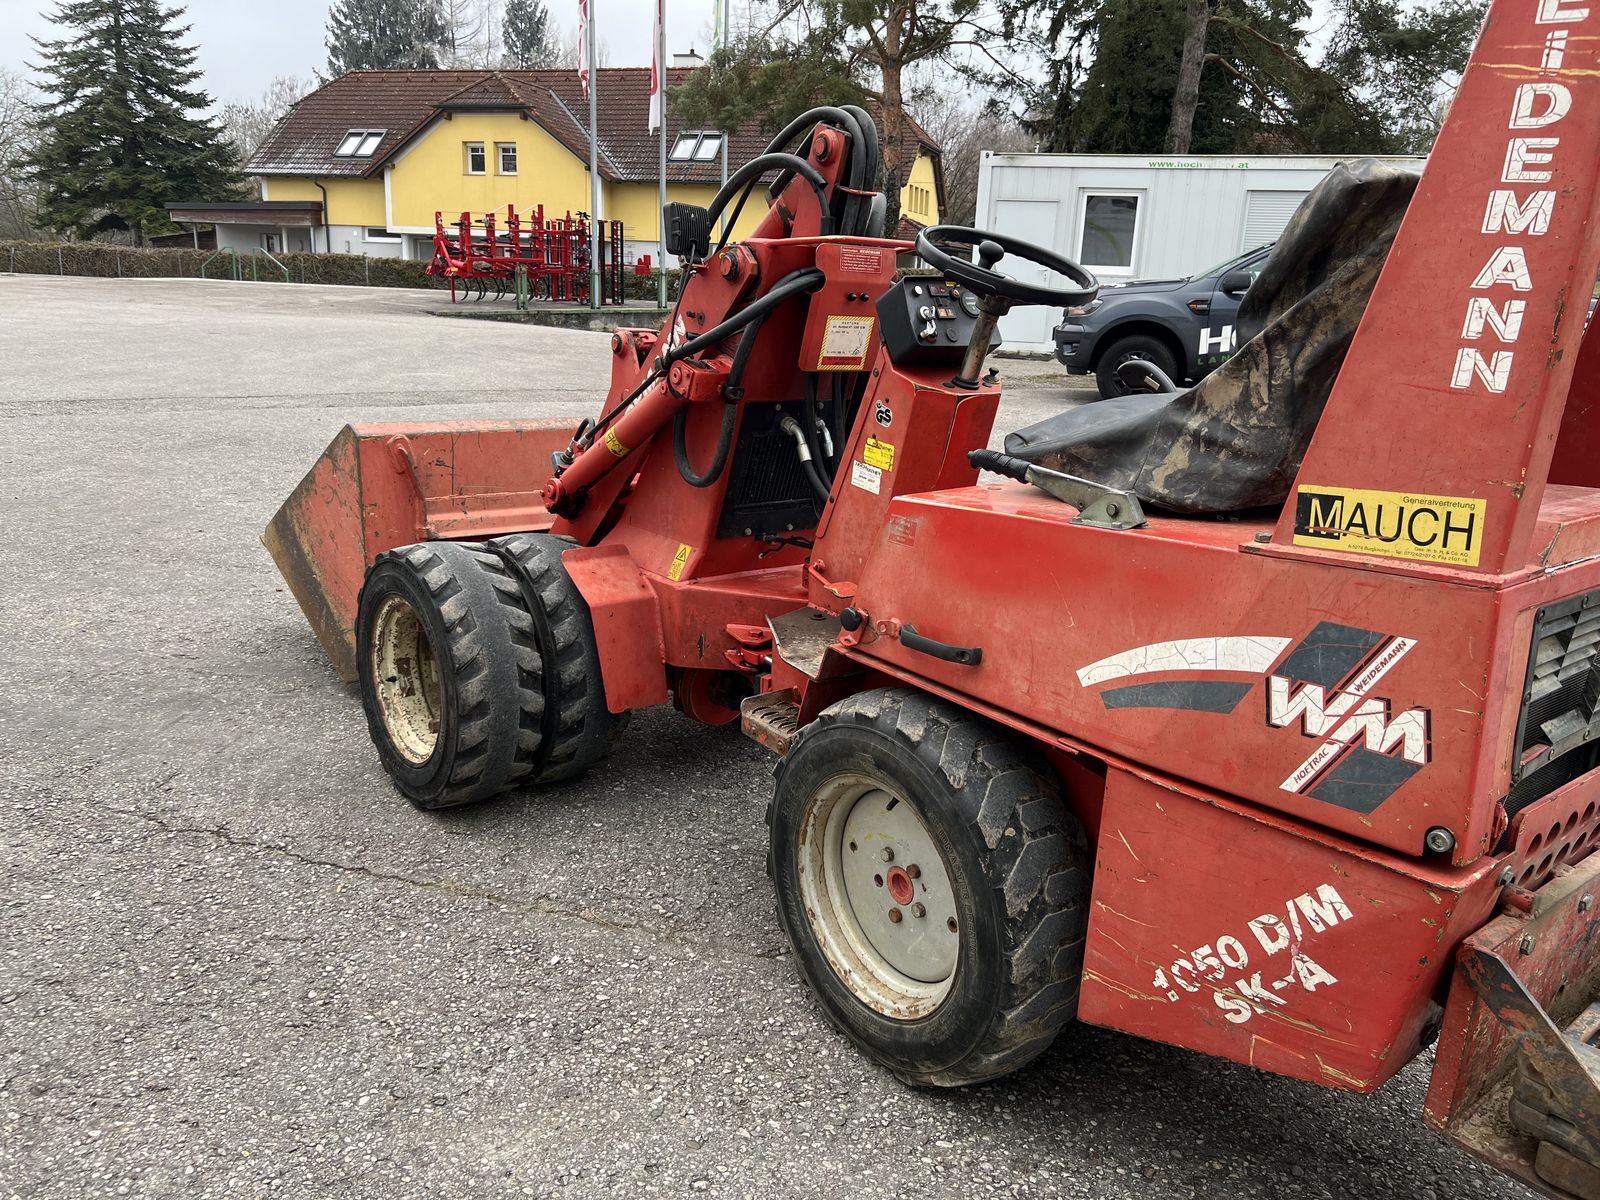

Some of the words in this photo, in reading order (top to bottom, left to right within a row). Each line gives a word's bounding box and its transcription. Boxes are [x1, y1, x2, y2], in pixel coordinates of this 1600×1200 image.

[1199, 325, 1237, 355] H
[1308, 497, 1475, 551] MAUCH
[1403, 496, 1476, 511] Generalvertretung
[1353, 639, 1408, 694] WEIDEMANN
[1293, 747, 1329, 784] HOFTRAC
[1247, 883, 1353, 956] D/M
[1213, 952, 1339, 1024] SK-A
